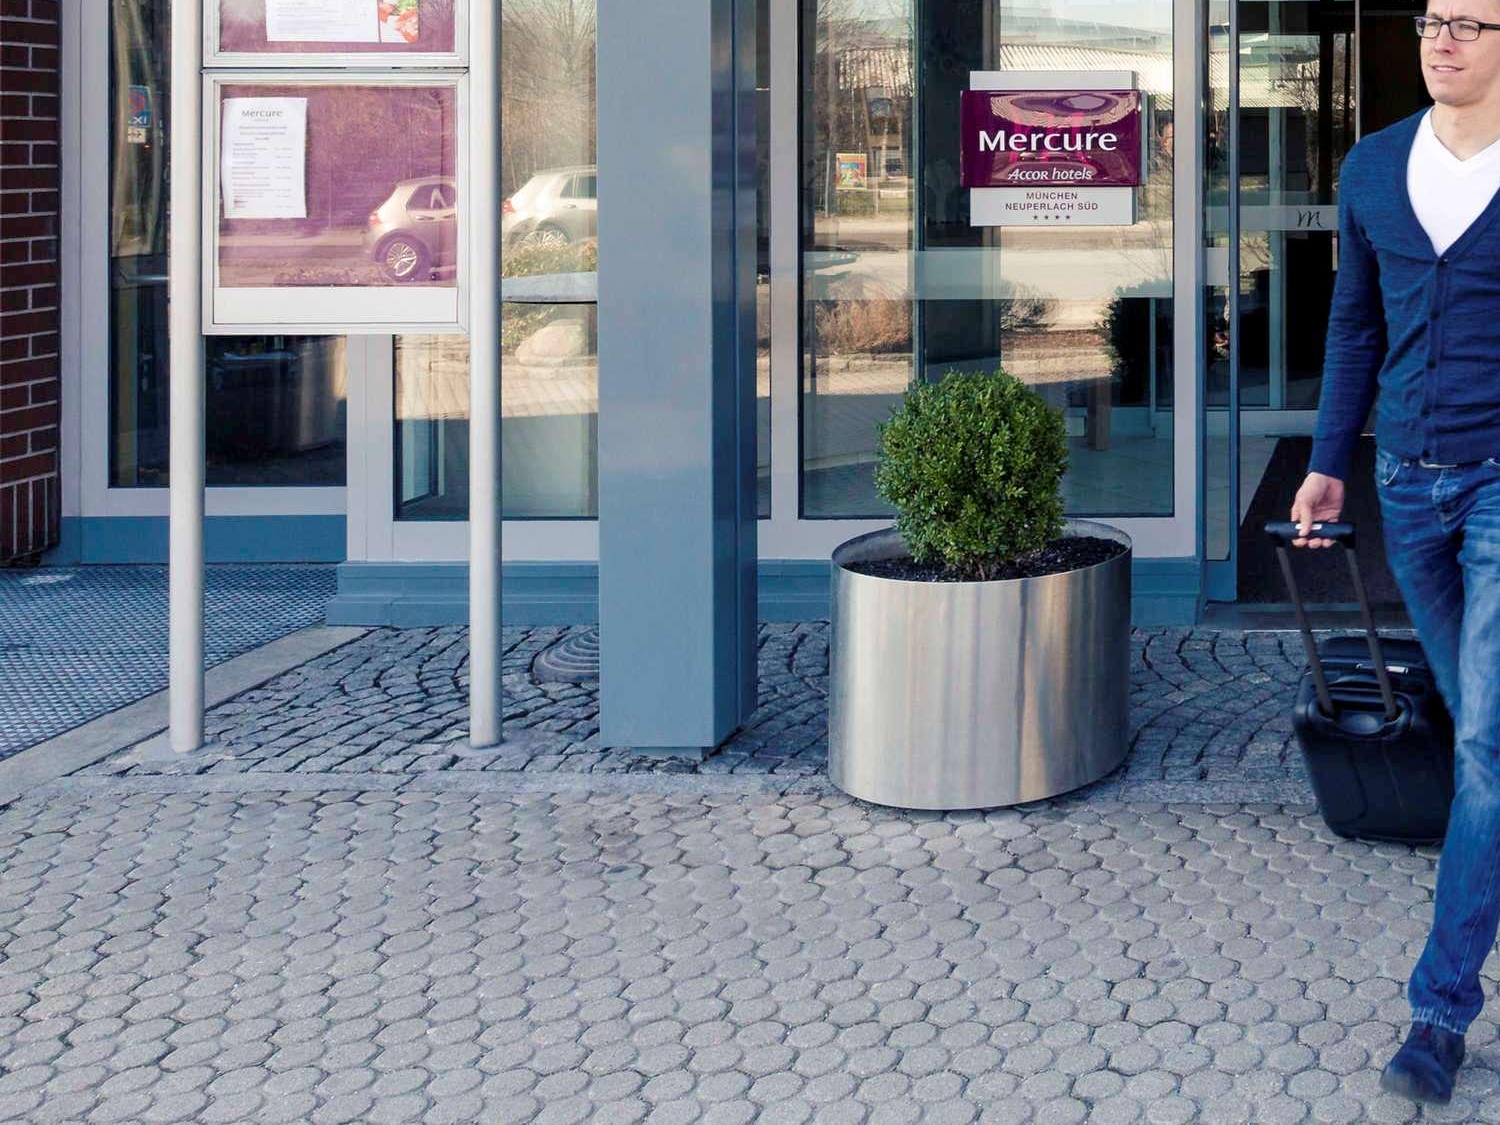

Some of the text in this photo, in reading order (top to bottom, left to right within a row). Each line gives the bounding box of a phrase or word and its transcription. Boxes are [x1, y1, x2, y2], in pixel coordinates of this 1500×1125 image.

[979, 129, 1118, 152] Mercure
[1052, 167, 1093, 181] hotels
[1026, 191, 1078, 200] MÜNCHEN
[1005, 201, 1099, 211] NEUPERLACH SÜD
